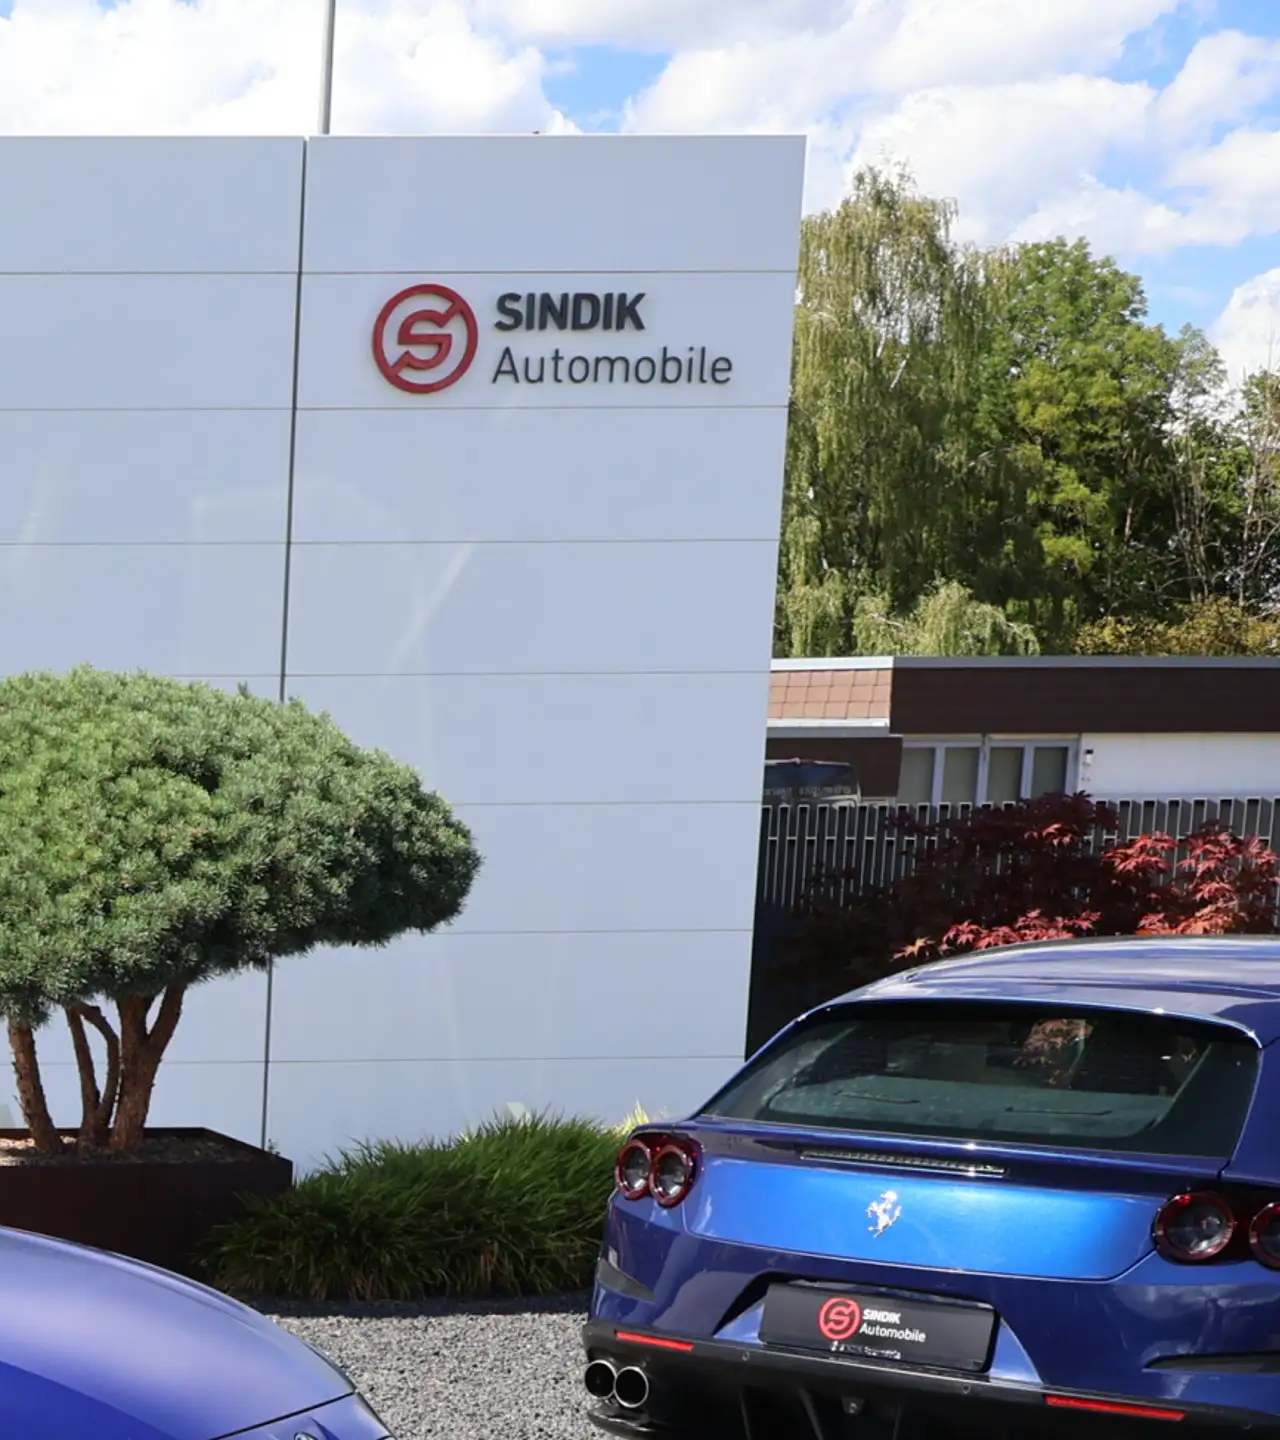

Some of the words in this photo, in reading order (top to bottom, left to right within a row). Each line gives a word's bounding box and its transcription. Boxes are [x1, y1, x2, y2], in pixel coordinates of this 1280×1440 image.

[494, 292, 647, 331] SINDIK
[491, 346, 733, 385] Automobile
[862, 1308, 901, 1324] SINDIK
[859, 1323, 926, 1342] Automobile
